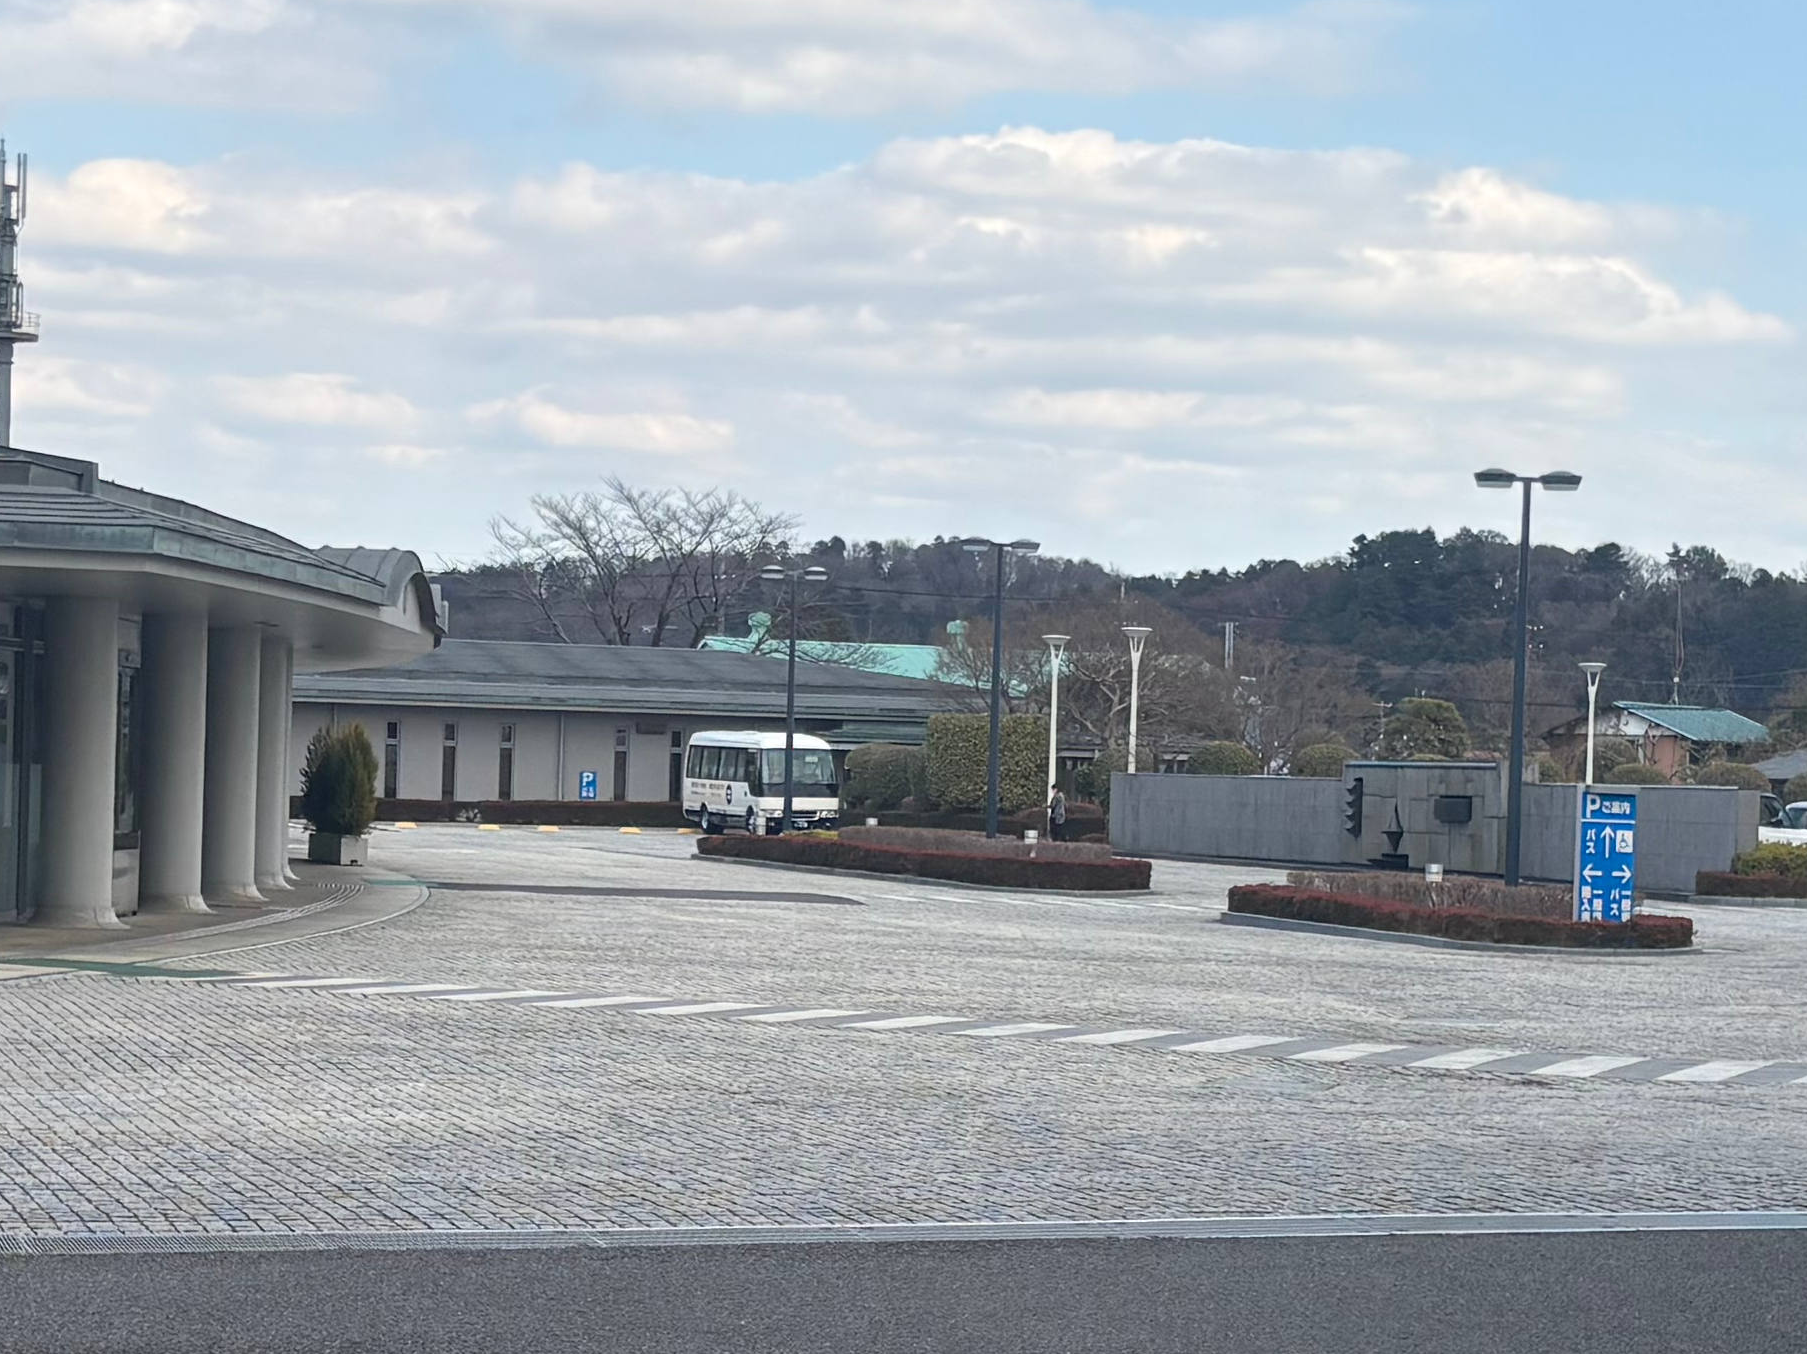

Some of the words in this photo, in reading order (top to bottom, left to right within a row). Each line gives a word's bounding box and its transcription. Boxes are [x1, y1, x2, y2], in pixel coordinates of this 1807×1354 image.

[582, 772, 594, 786] P
[1586, 794, 1601, 818] P
[1585, 828, 1596, 854] バス
[1610, 888, 1620, 916] バス
